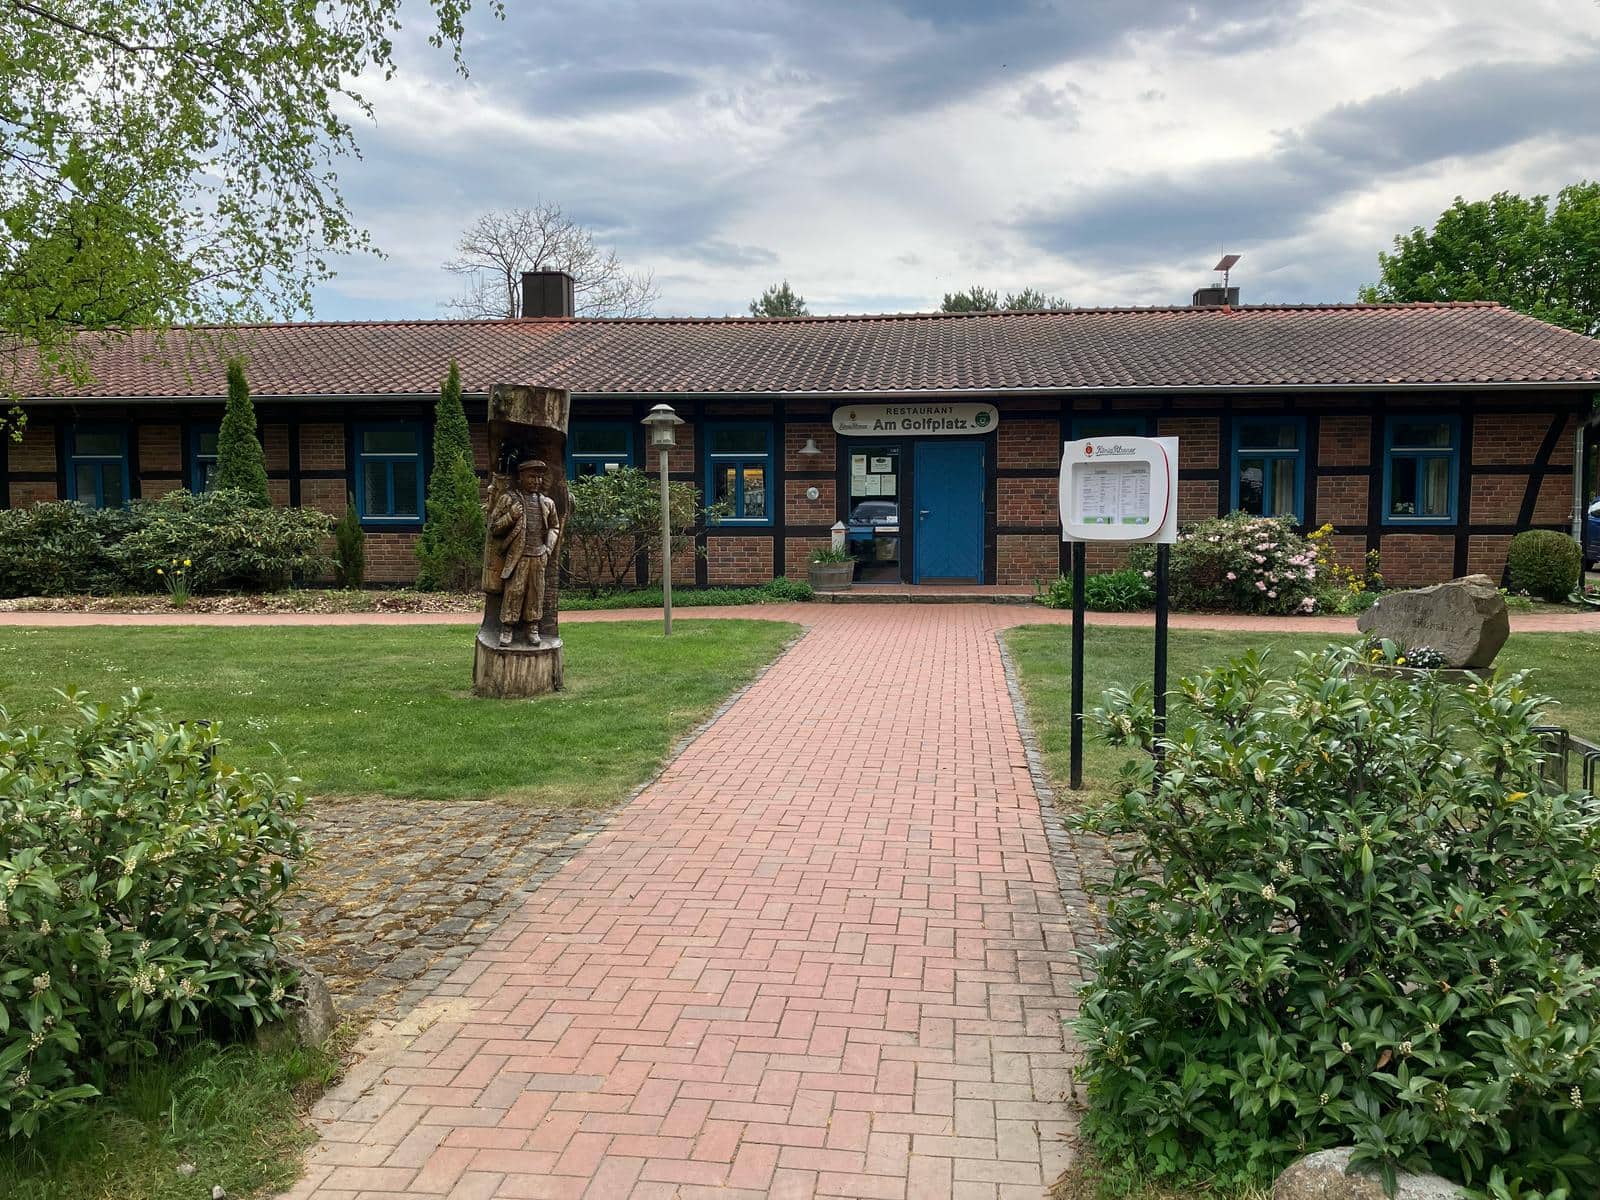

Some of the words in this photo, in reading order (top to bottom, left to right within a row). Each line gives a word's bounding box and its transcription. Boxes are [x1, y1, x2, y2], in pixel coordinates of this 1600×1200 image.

[886, 407, 954, 415] RESTAURANT
[872, 419, 897, 431] Am
[901, 417, 968, 432] Golfplatz
